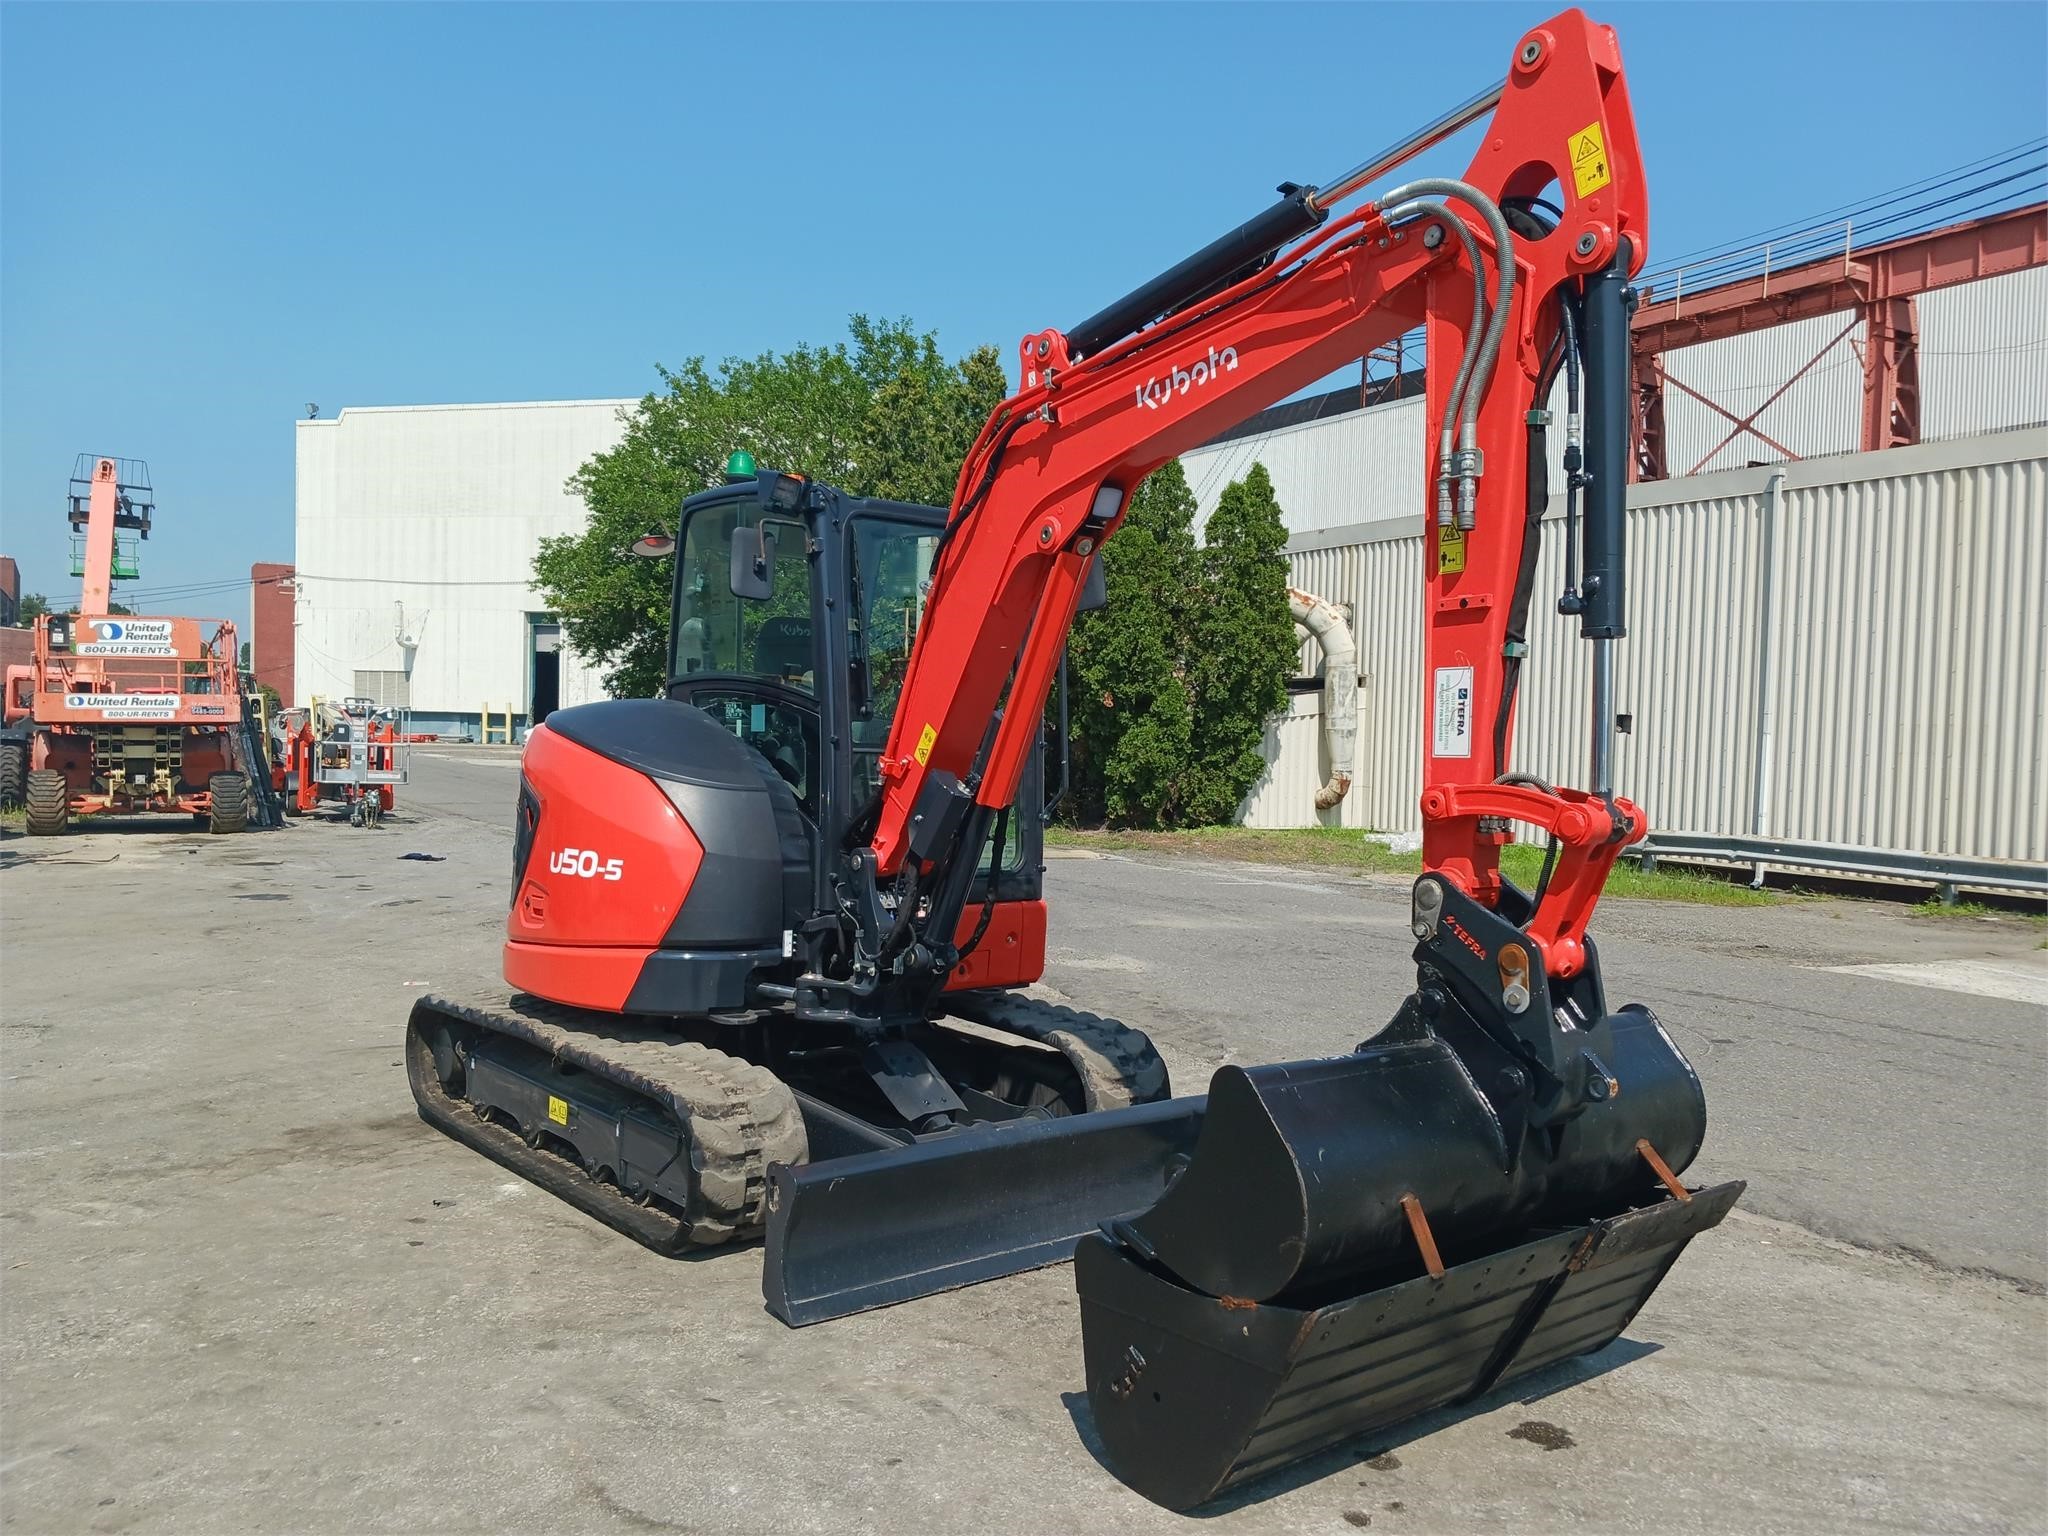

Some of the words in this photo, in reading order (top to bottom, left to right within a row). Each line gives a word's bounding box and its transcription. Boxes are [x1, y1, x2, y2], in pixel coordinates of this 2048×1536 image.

[1135, 346, 1238, 409] Kubota
[125, 623, 165, 632] United
[780, 624, 810, 636] Kubo
[125, 633, 169, 641] Rentals
[84, 646, 171, 654] 800-UR-RENTS
[87, 697, 127, 706] United
[131, 698, 175, 707] Rentals
[550, 847, 624, 880] U50-5
[1453, 923, 1487, 961] TEFRA
